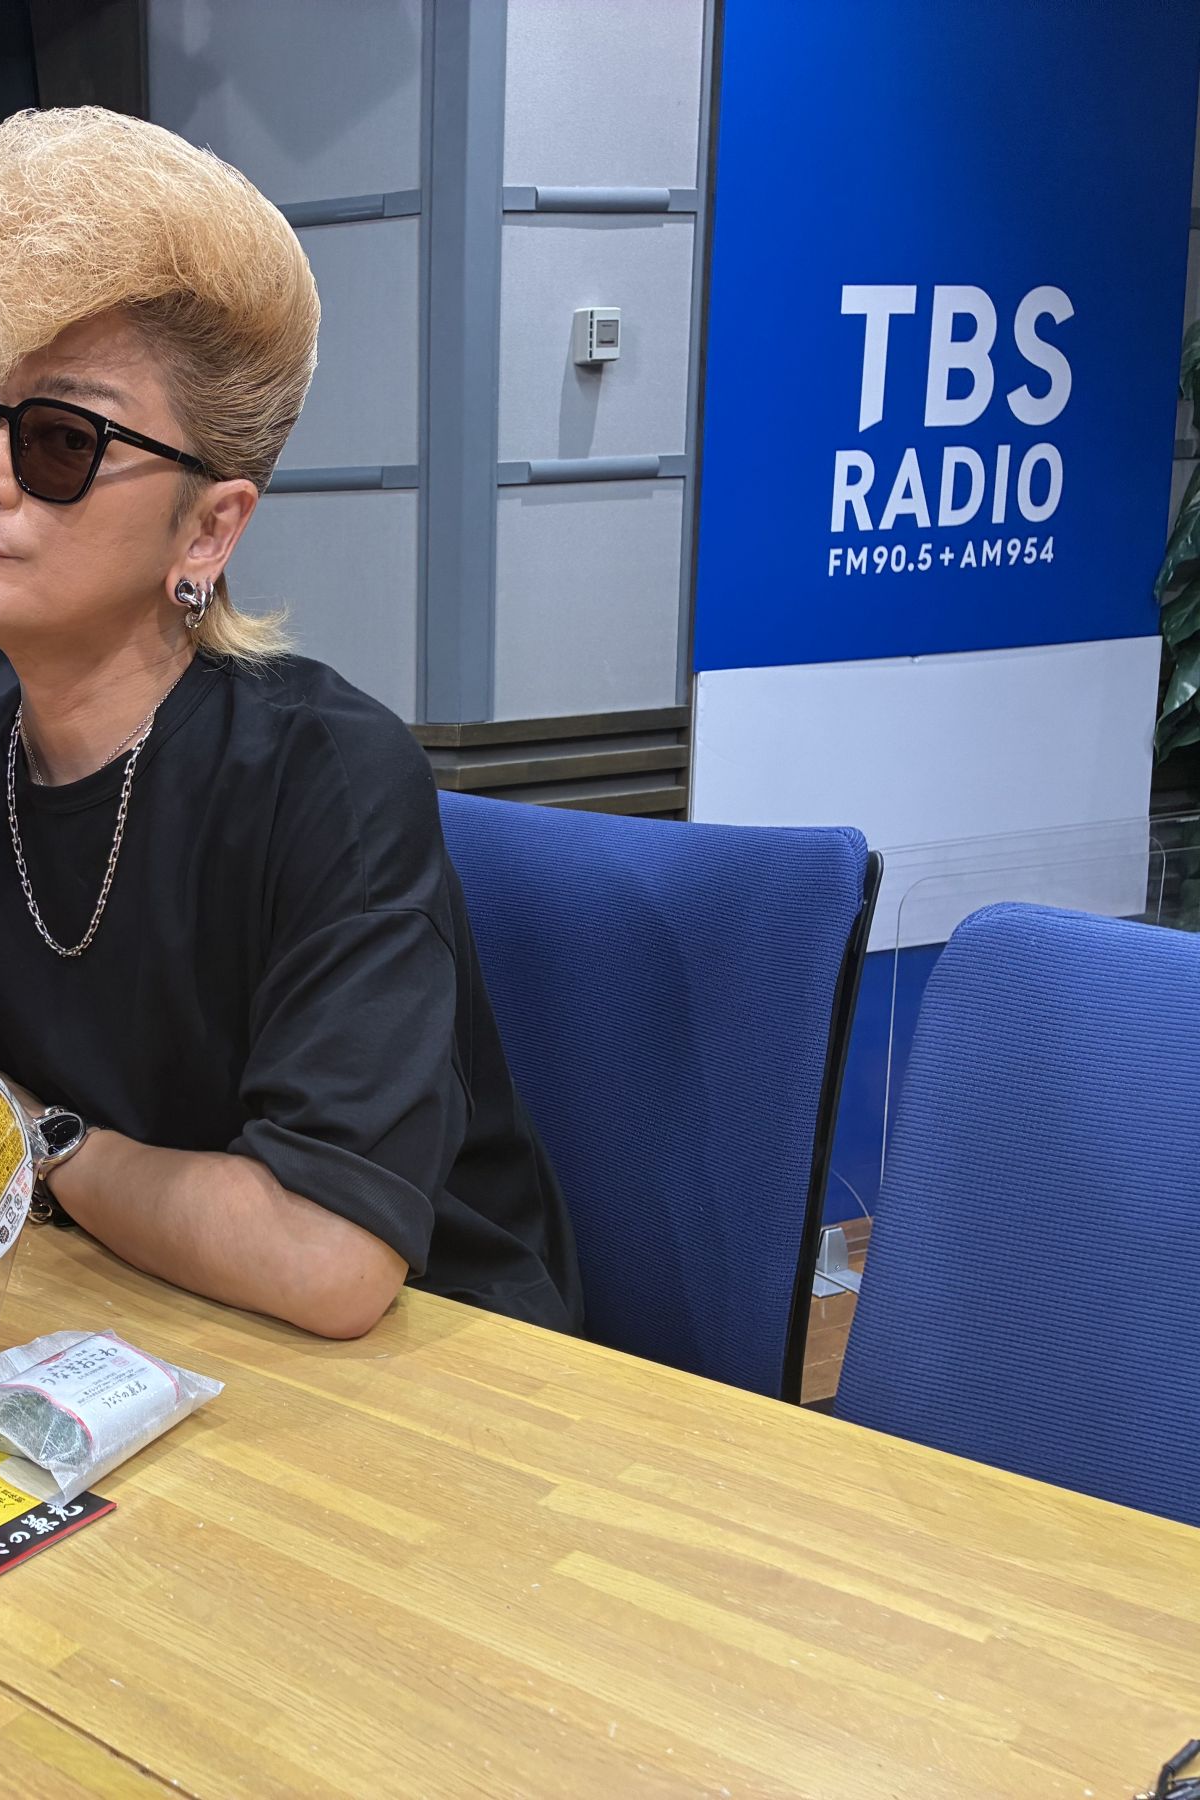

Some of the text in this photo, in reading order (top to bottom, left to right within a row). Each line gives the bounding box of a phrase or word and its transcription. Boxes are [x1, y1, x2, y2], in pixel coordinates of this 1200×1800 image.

[840, 285, 1075, 432] TBS
[830, 442, 1063, 532] RADIO
[40, 1347, 118, 1386] うなぎおこわ
